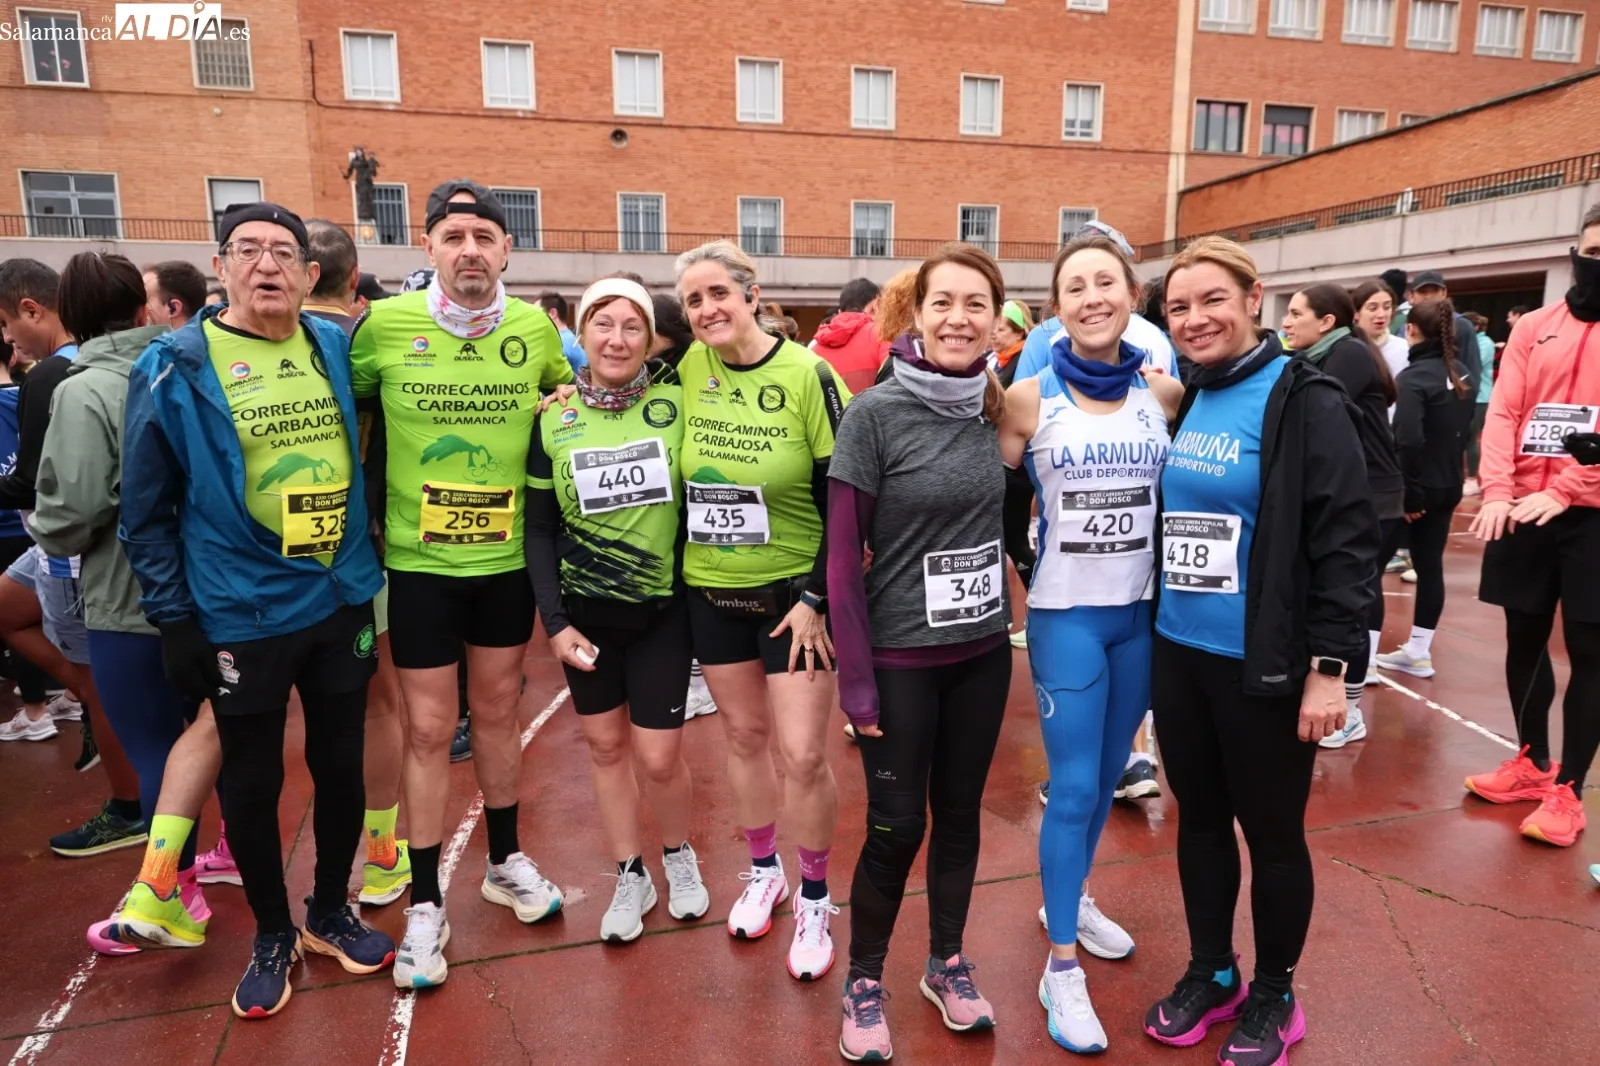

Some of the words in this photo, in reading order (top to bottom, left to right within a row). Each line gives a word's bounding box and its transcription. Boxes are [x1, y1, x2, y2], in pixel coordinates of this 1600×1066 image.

[225, 374, 264, 390] CARBAJOSA
[402, 382, 530, 396] CORRECAMINOS
[416, 400, 520, 412] CARBAJOSA
[828, 386, 840, 420] CARBA
[432, 416, 506, 425] SALAMANCA
[552, 422, 588, 435] CARBAJOSA
[688, 416, 788, 438] CORRECAMINOS
[270, 431, 341, 449] SALAMANCA
[693, 432, 773, 452] CARBAJOSA
[1172, 431, 1240, 464] ARMUÑA
[615, 451, 637, 460] BOSCO
[698, 448, 759, 465] SALAMANCA
[1051, 446, 1075, 469] LA
[1082, 438, 1168, 466] ARMUÑA
[598, 465, 645, 490] 440
[1064, 468, 1092, 480] CLUB
[1096, 468, 1156, 478] DEPORTIVO
[445, 510, 490, 530] 256
[704, 508, 745, 528] 435
[1082, 513, 1133, 537] 420
[1186, 525, 1209, 533] BOSCO
[1167, 542, 1209, 568] 418
[950, 574, 991, 602] 348
